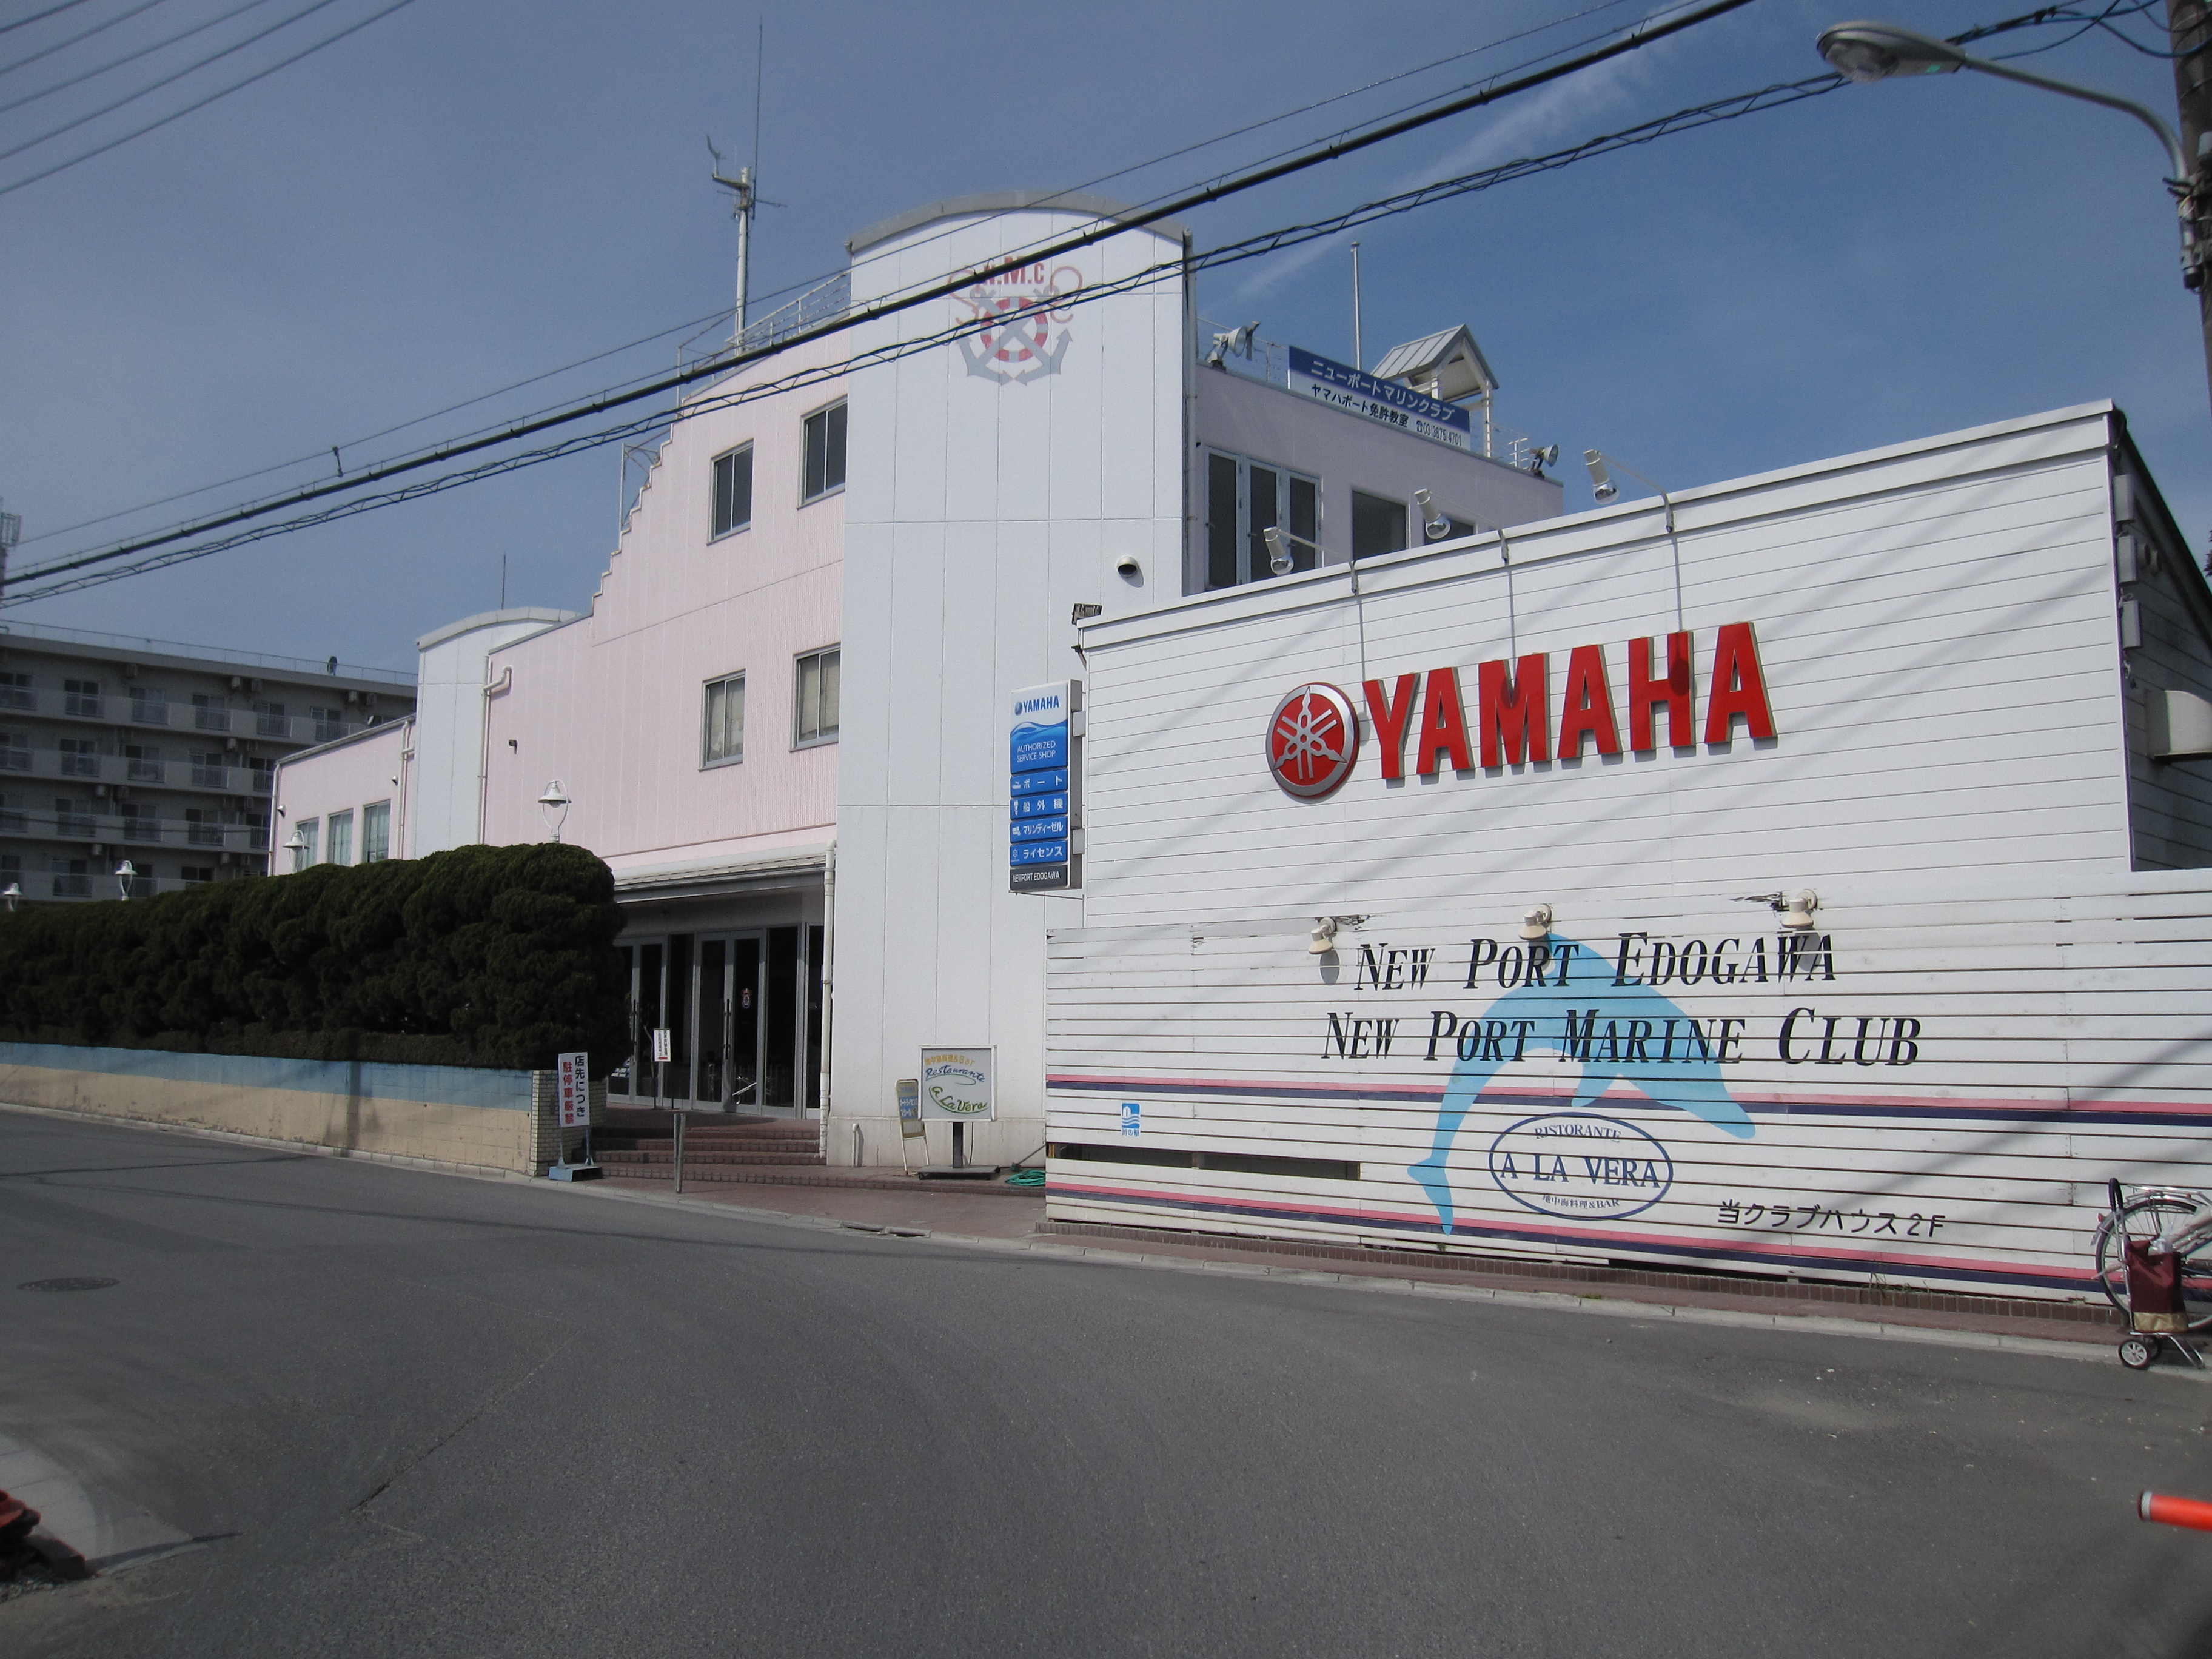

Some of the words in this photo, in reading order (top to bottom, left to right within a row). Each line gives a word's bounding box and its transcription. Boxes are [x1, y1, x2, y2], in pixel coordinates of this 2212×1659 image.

[1311, 361, 1455, 420] ニューポートマリンクラブ
[1311, 384, 1409, 428] ヤマハボート免許教室
[1023, 695, 1060, 713] YAMAHA
[1362, 621, 1778, 780] YAMAHA
[1017, 740, 1056, 753] AUTHORIZED
[1017, 752, 1037, 763] SERVICE
[1039, 749, 1056, 759] SHOP
[1023, 798, 1064, 813] 船外機
[1023, 821, 1064, 835] マリンディーゼル
[1023, 846, 1063, 859] ライセンス
[1034, 871, 1060, 880] EDOGAWA
[1354, 943, 1436, 991] NEW
[1463, 939, 1579, 990] PORT
[1610, 931, 1837, 987] EDOGAWA
[1321, 1011, 1399, 1060] NEW
[1423, 1011, 1535, 1062] PORT
[1558, 1009, 1746, 1064] MARINE
[1778, 1007, 1922, 1067] CLUB
[925, 1065, 985, 1082] Restaurante
[563, 1062, 575, 1125] 駐停車厳禁
[575, 1056, 586, 1118] 店先につき
[957, 1099, 988, 1111] Vera
[1535, 1124, 1622, 1143] RISTORANTE
[1500, 1152, 1519, 1179] A
[1533, 1153, 1569, 1182] LA
[1583, 1156, 1661, 1188] VERA
